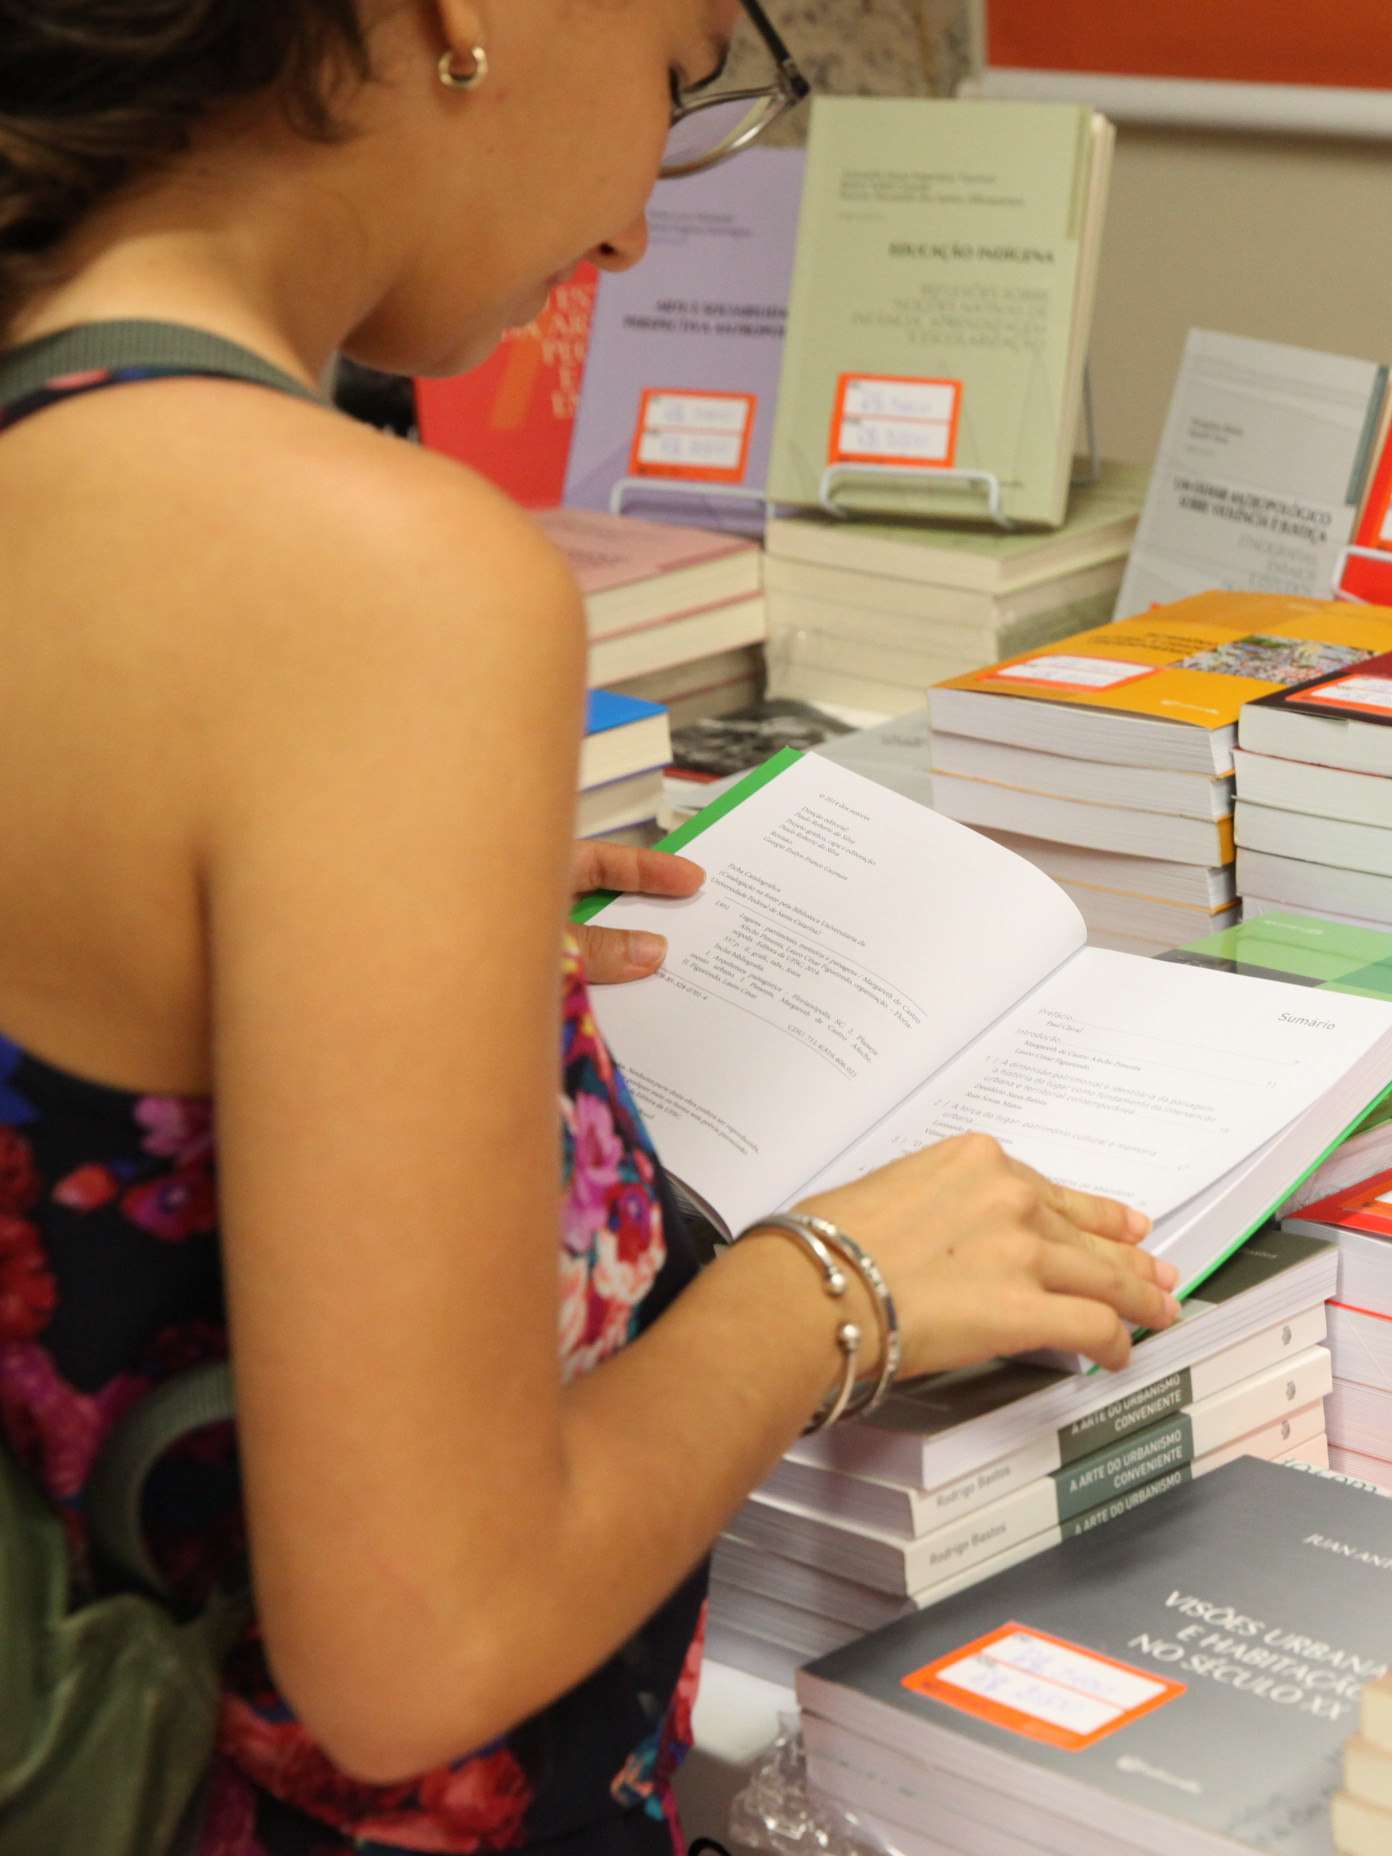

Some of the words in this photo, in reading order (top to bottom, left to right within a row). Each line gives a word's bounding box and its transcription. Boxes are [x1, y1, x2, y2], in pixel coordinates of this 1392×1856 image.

[1277, 1010, 1337, 1033] Sumário
[1114, 1389, 1182, 1432] CONVENIENTE
[1123, 1373, 1181, 1409] URBANISMO
[1069, 1479, 1078, 1493] A
[1079, 1466, 1105, 1488] ARTE
[1107, 1457, 1122, 1474] DO
[1122, 1429, 1182, 1469] URBANISMO
[1113, 1445, 1183, 1489] CONVENIENTE
[936, 1482, 975, 1508] Rodrigo
[976, 1465, 1011, 1489] Bastos
[1074, 1523, 1082, 1536] A
[1083, 1509, 1109, 1530] ARTE
[1110, 1500, 1125, 1517] DO
[1125, 1471, 1182, 1511] URBANISMO
[929, 1540, 970, 1567] Rodrigo
[970, 1523, 1007, 1547] Bastos
[1302, 1533, 1356, 1557] JUAN
[1164, 1589, 1266, 1637] VISÕES
[1176, 1624, 1203, 1642] E
[1127, 1633, 1186, 1663] NO
[1181, 1649, 1304, 1705] SÉCULO
[1300, 1694, 1352, 1723] XX
